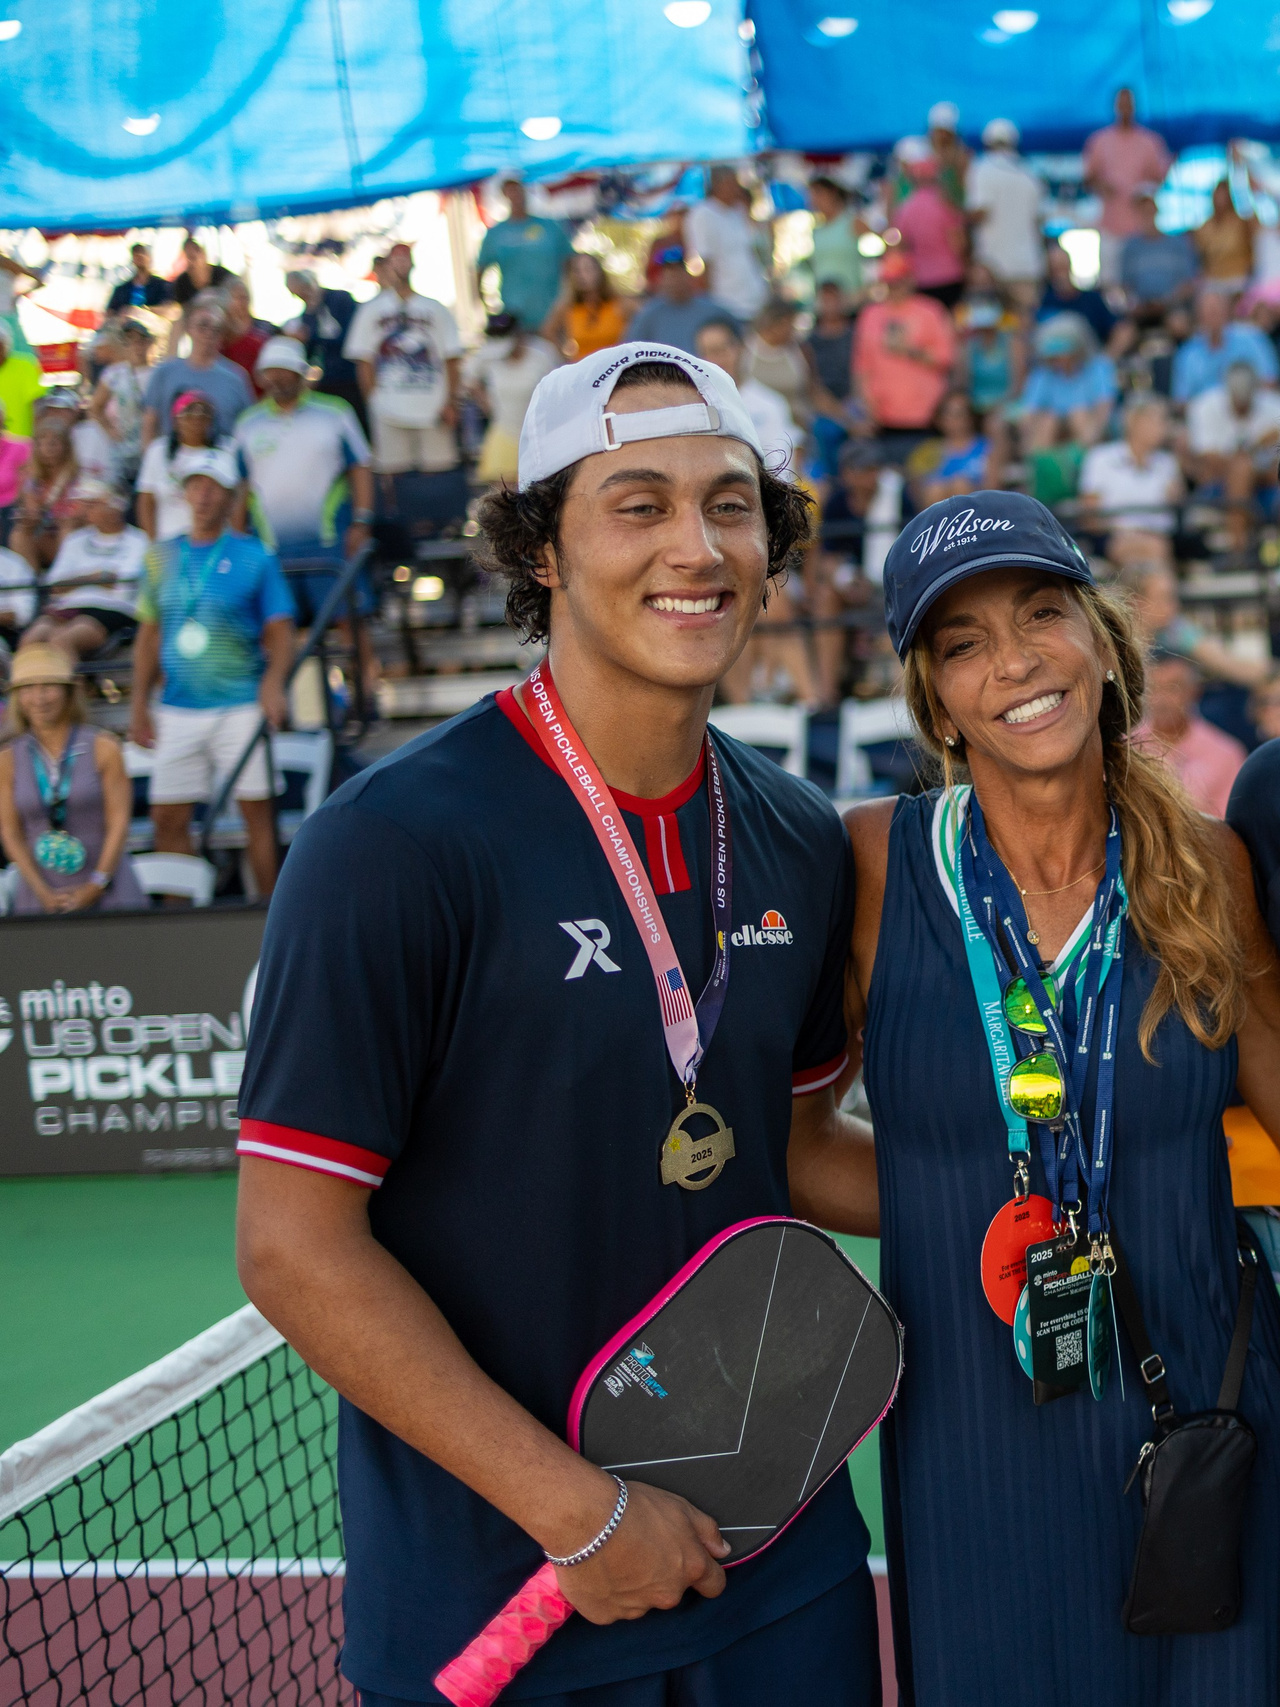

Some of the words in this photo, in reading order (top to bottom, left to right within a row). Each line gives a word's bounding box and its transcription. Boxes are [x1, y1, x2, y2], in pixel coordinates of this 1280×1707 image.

[592, 356, 629, 388] PROXR
[910, 508, 1015, 565] Wilson
[943, 541, 956, 552] est
[956, 534, 978, 546] 1914
[709, 750, 726, 839] PICKLEBALL
[532, 682, 557, 724] OPEN
[549, 723, 604, 814] PICKLEBALL
[602, 814, 661, 945] CHAMPIONSHIPS
[717, 841, 727, 885] OPEN
[717, 886, 726, 909] US
[731, 924, 794, 947] ellesse
[19, 978, 133, 1020] minto
[24, 1018, 96, 1057] US
[101, 1011, 244, 1055] OPEN
[29, 1050, 246, 1102] PICKLE
[35, 1099, 240, 1136] CHAMPIO
[690, 1147, 713, 1163] 2025
[1014, 1211, 1031, 1222] 2025
[1031, 1248, 1053, 1264] 2025
[1042, 1269, 1058, 1279] minto
[1043, 1271, 1092, 1291] PICKLEBALL
[1036, 1328, 1051, 1338] SCAN
[1051, 1324, 1061, 1333] THE
[1062, 1320, 1071, 1330] QR
[1070, 1317, 1082, 1327] CODE
[1040, 1321, 1049, 1329] For
[1050, 1311, 1077, 1325] everything
[1077, 1308, 1084, 1316] US
[606, 1376, 619, 1389] USA
